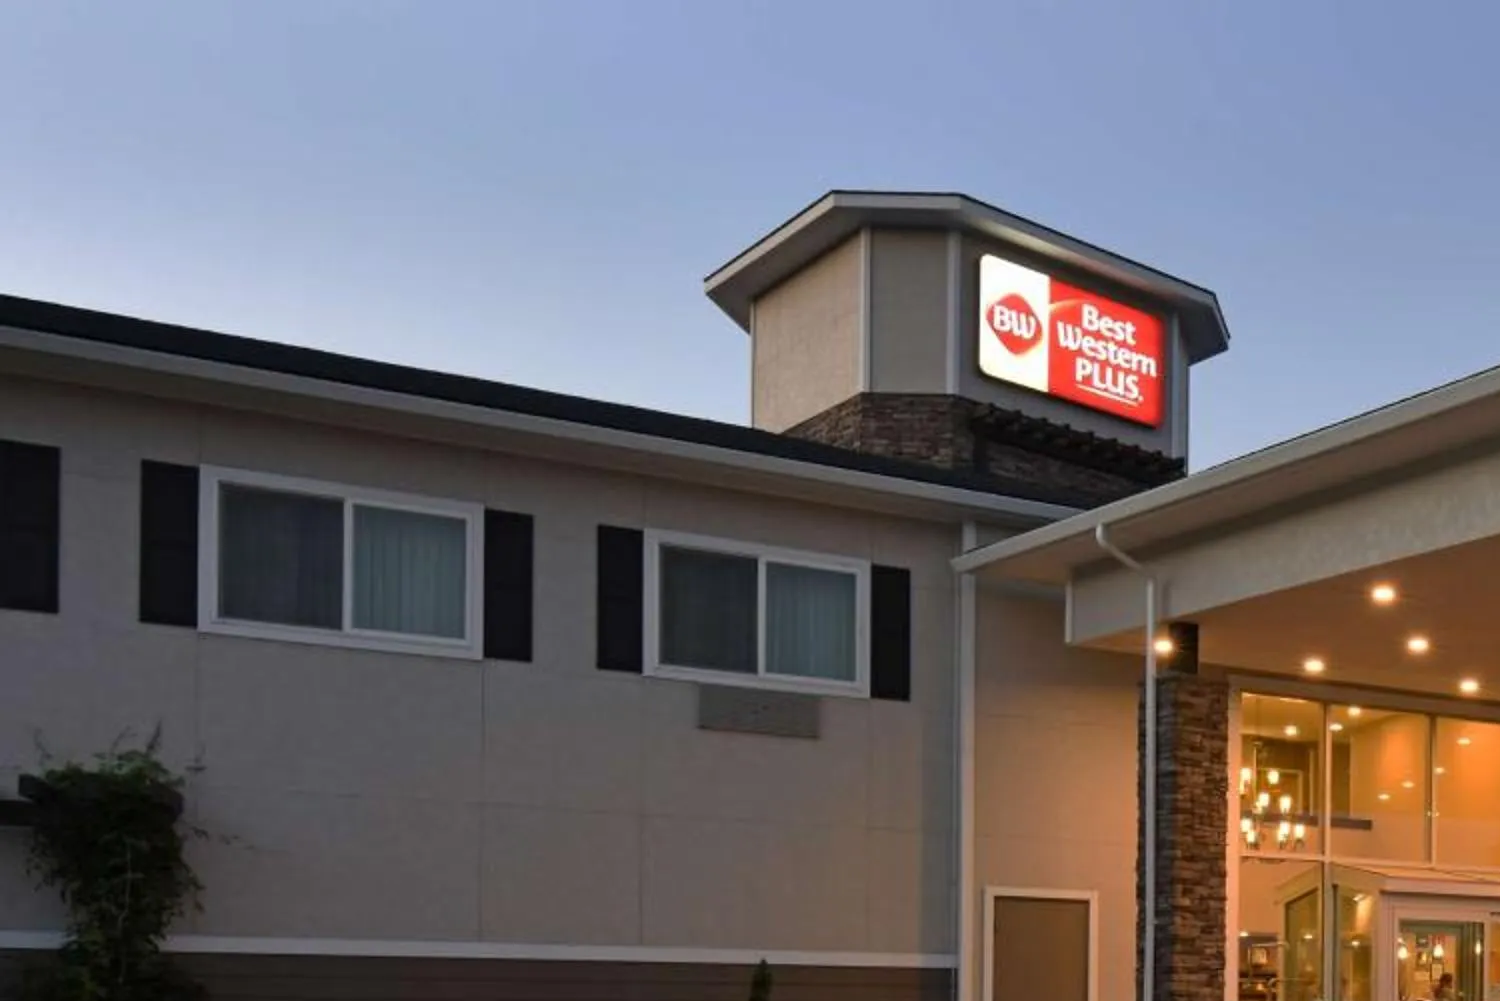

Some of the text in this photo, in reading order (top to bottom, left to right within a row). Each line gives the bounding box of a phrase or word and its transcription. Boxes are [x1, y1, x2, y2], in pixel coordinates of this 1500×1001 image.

[993, 305, 1036, 339] BW
[1082, 304, 1136, 344] Best
[1057, 321, 1157, 377] Western
[1075, 356, 1140, 399] PLUS
